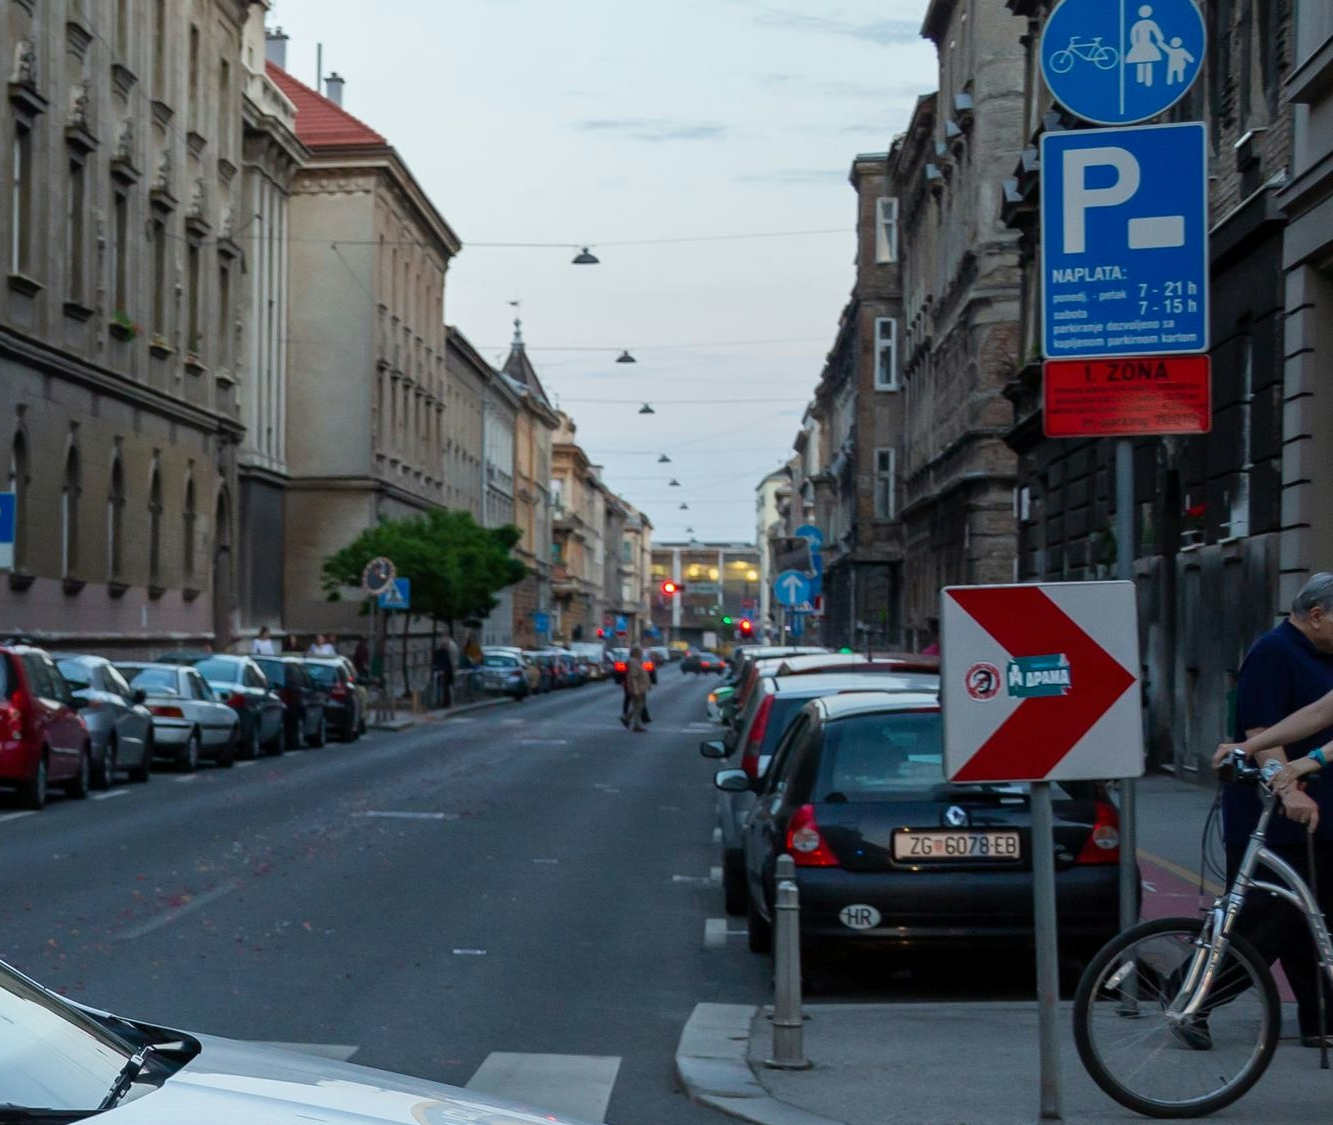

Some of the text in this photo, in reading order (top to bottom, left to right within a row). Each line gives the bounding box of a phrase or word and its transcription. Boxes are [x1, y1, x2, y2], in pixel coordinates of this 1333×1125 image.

[1063, 147, 1140, 254] P
[1052, 266, 1127, 283] NAPLATA:
[1138, 284, 1148, 297] 7
[1165, 281, 1182, 296] 21
[1188, 281, 1197, 295] h
[1138, 302, 1148, 315] 7
[1165, 300, 1182, 313] 15
[1188, 300, 1197, 313] h
[1107, 362, 1169, 381] ZONA
[910, 837, 932, 855] ZG
[847, 908, 872, 926] HR
